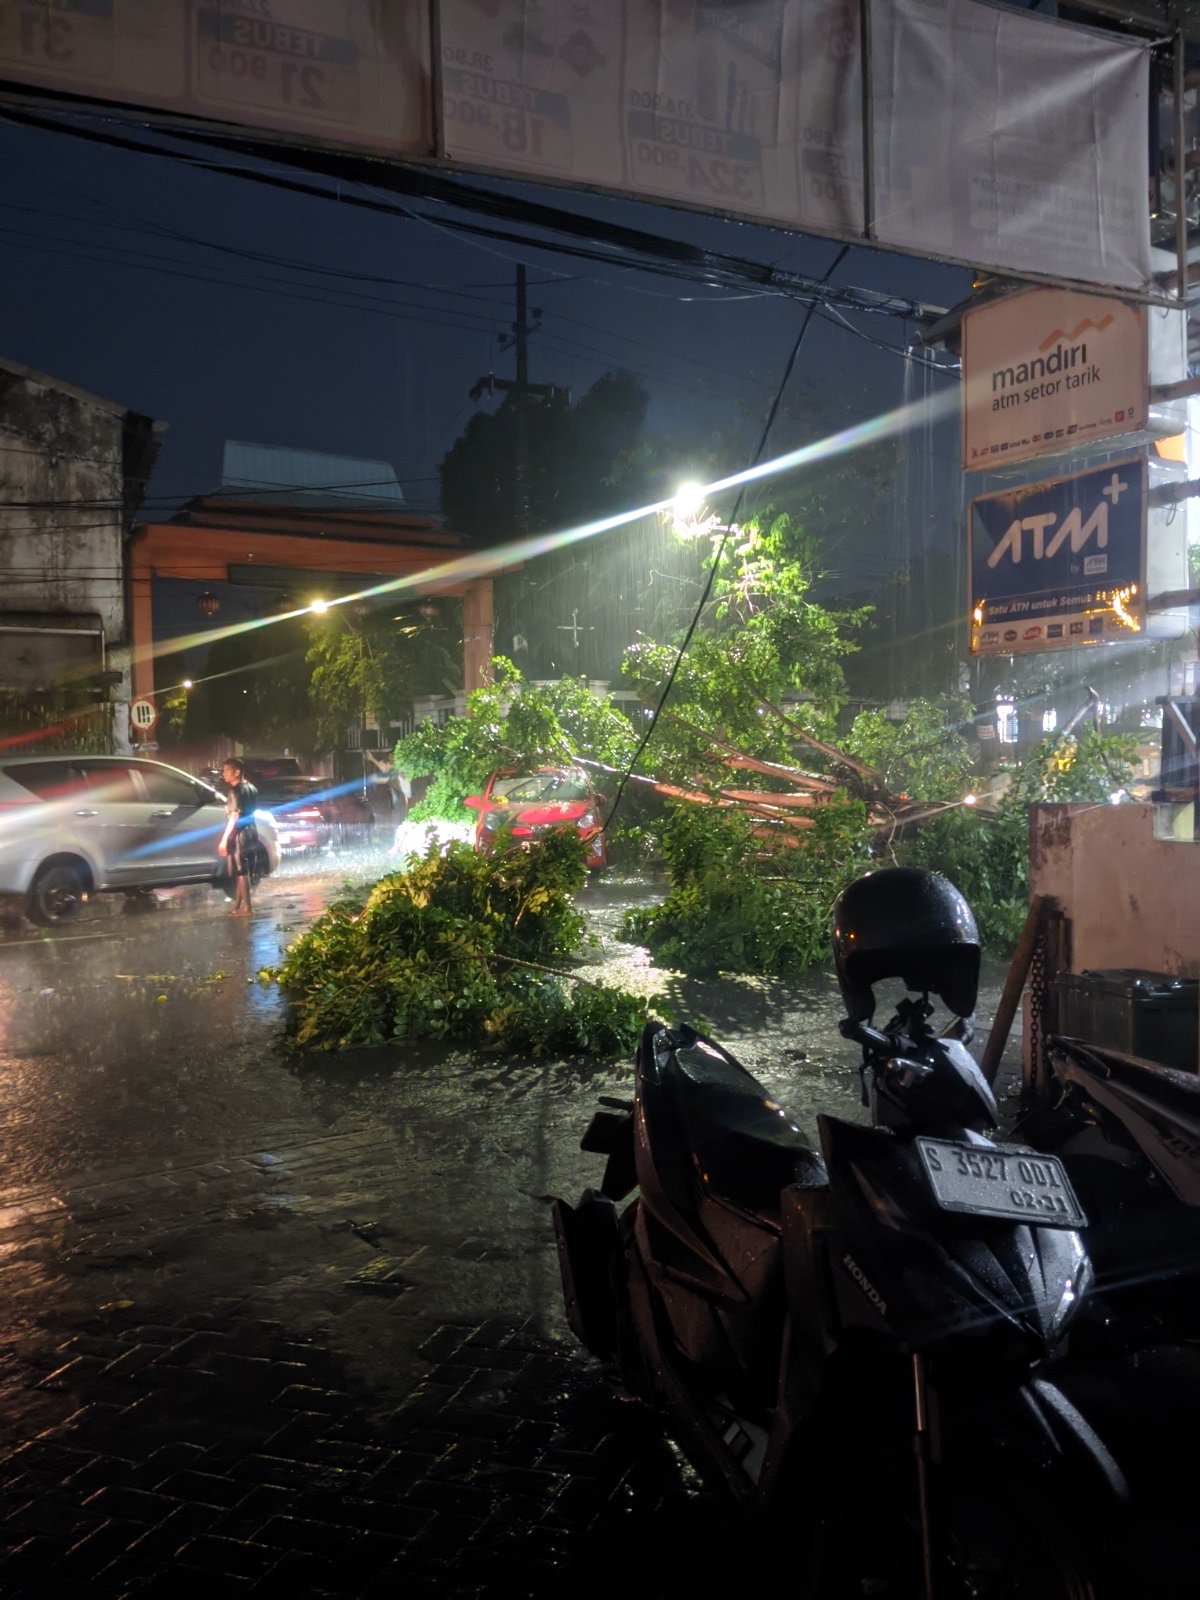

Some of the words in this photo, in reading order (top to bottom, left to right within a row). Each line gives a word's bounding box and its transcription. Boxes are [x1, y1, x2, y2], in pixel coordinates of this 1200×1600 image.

[992, 344, 1087, 392] mandiri
[992, 393, 1020, 412] atm
[1024, 379, 1062, 403] setor
[1065, 364, 1101, 390] tarik
[988, 606, 1009, 616] Satu
[1009, 602, 1030, 613] ATM
[1031, 598, 1058, 610] untuk
[925, 1147, 943, 1172] S
[952, 1150, 1009, 1182] 3527
[842, 1253, 887, 1316] HONDA
